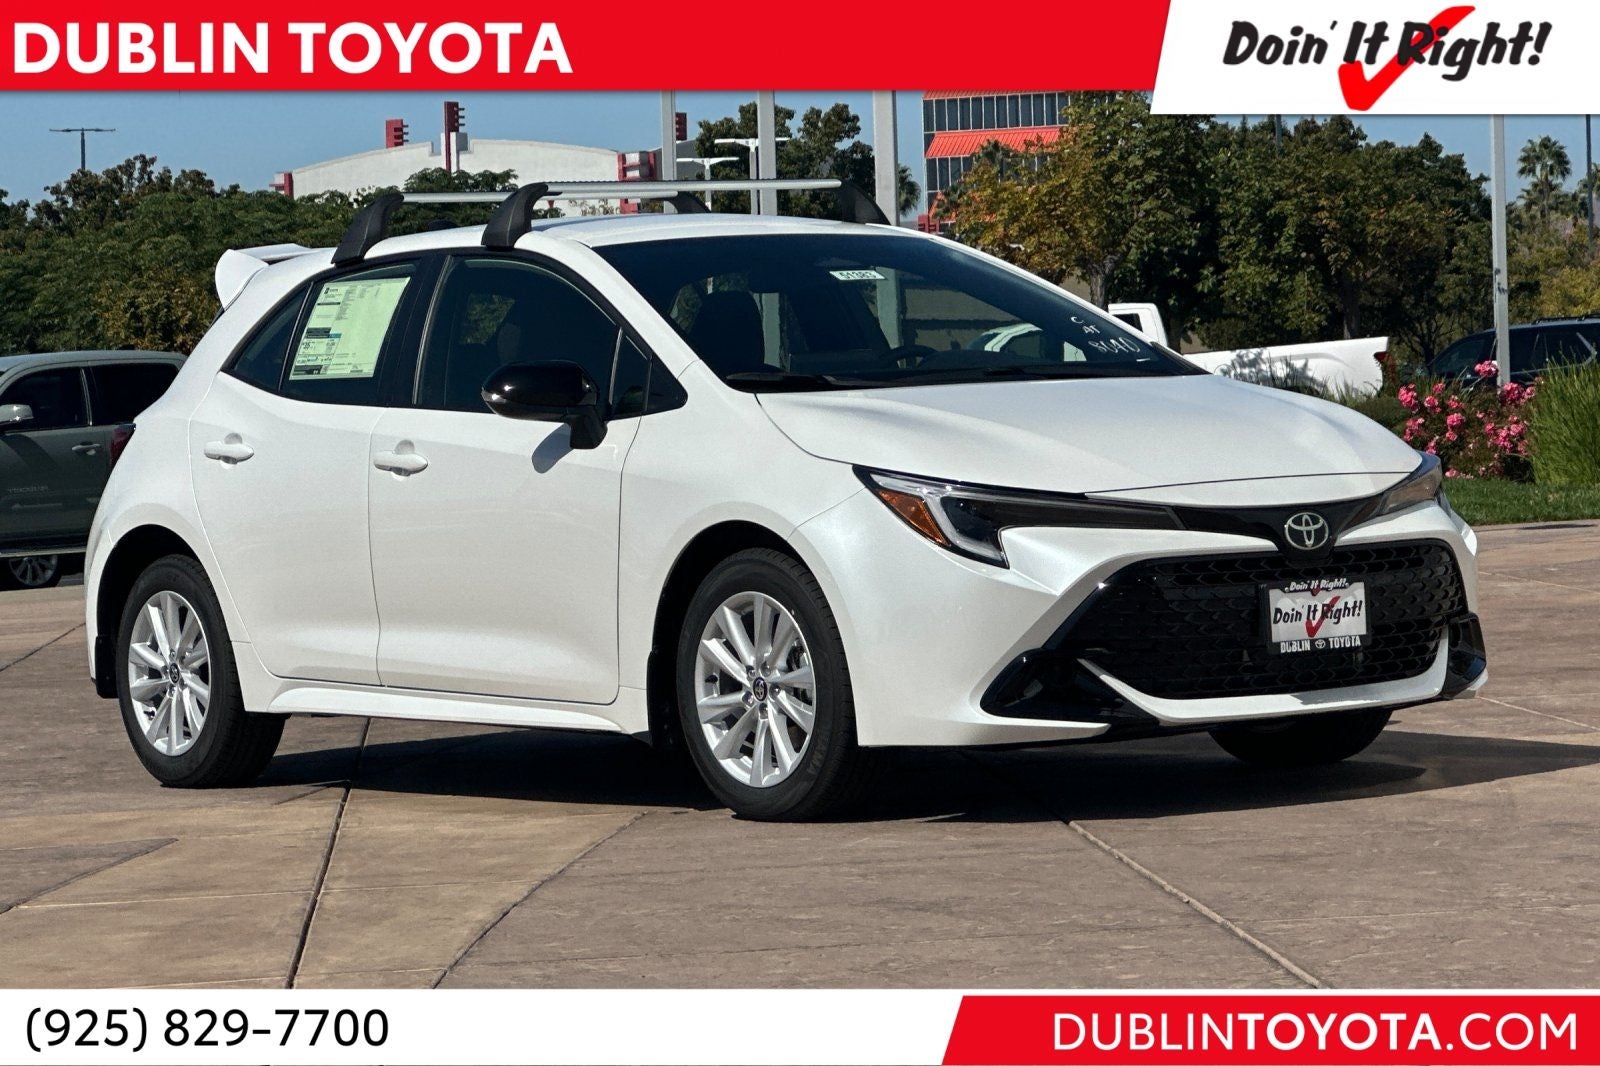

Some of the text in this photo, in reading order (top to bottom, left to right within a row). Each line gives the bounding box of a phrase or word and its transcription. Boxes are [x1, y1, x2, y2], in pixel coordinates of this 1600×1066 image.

[1310, 580, 1320, 588] It
[1306, 603, 1319, 621] It
[1321, 600, 1363, 625] Right!
[1280, 635, 1361, 653] DUBLIN TOYOTA
